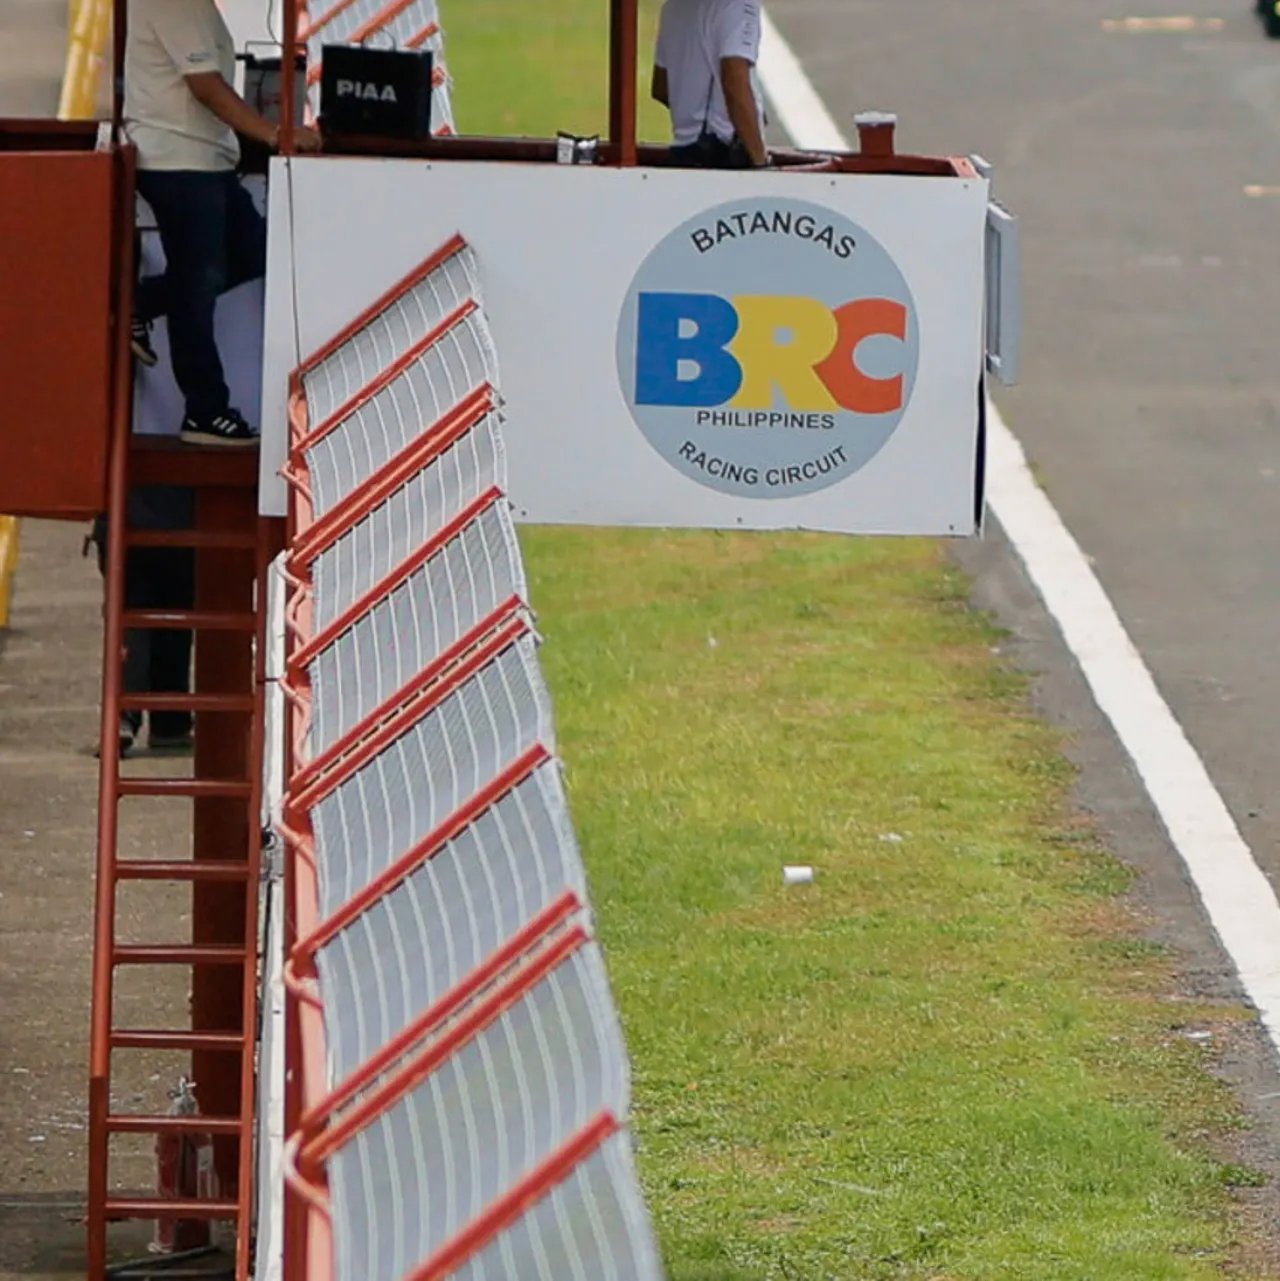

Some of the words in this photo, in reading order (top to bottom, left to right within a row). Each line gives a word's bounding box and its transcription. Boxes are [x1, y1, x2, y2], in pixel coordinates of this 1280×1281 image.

[335, 78, 398, 103] PIAA
[690, 210, 857, 260] BATANGAS
[634, 290, 908, 415] BRC
[696, 410, 835, 431] PHILIPPINES
[678, 440, 760, 487] RACING
[765, 445, 849, 488] CIRCUIT
